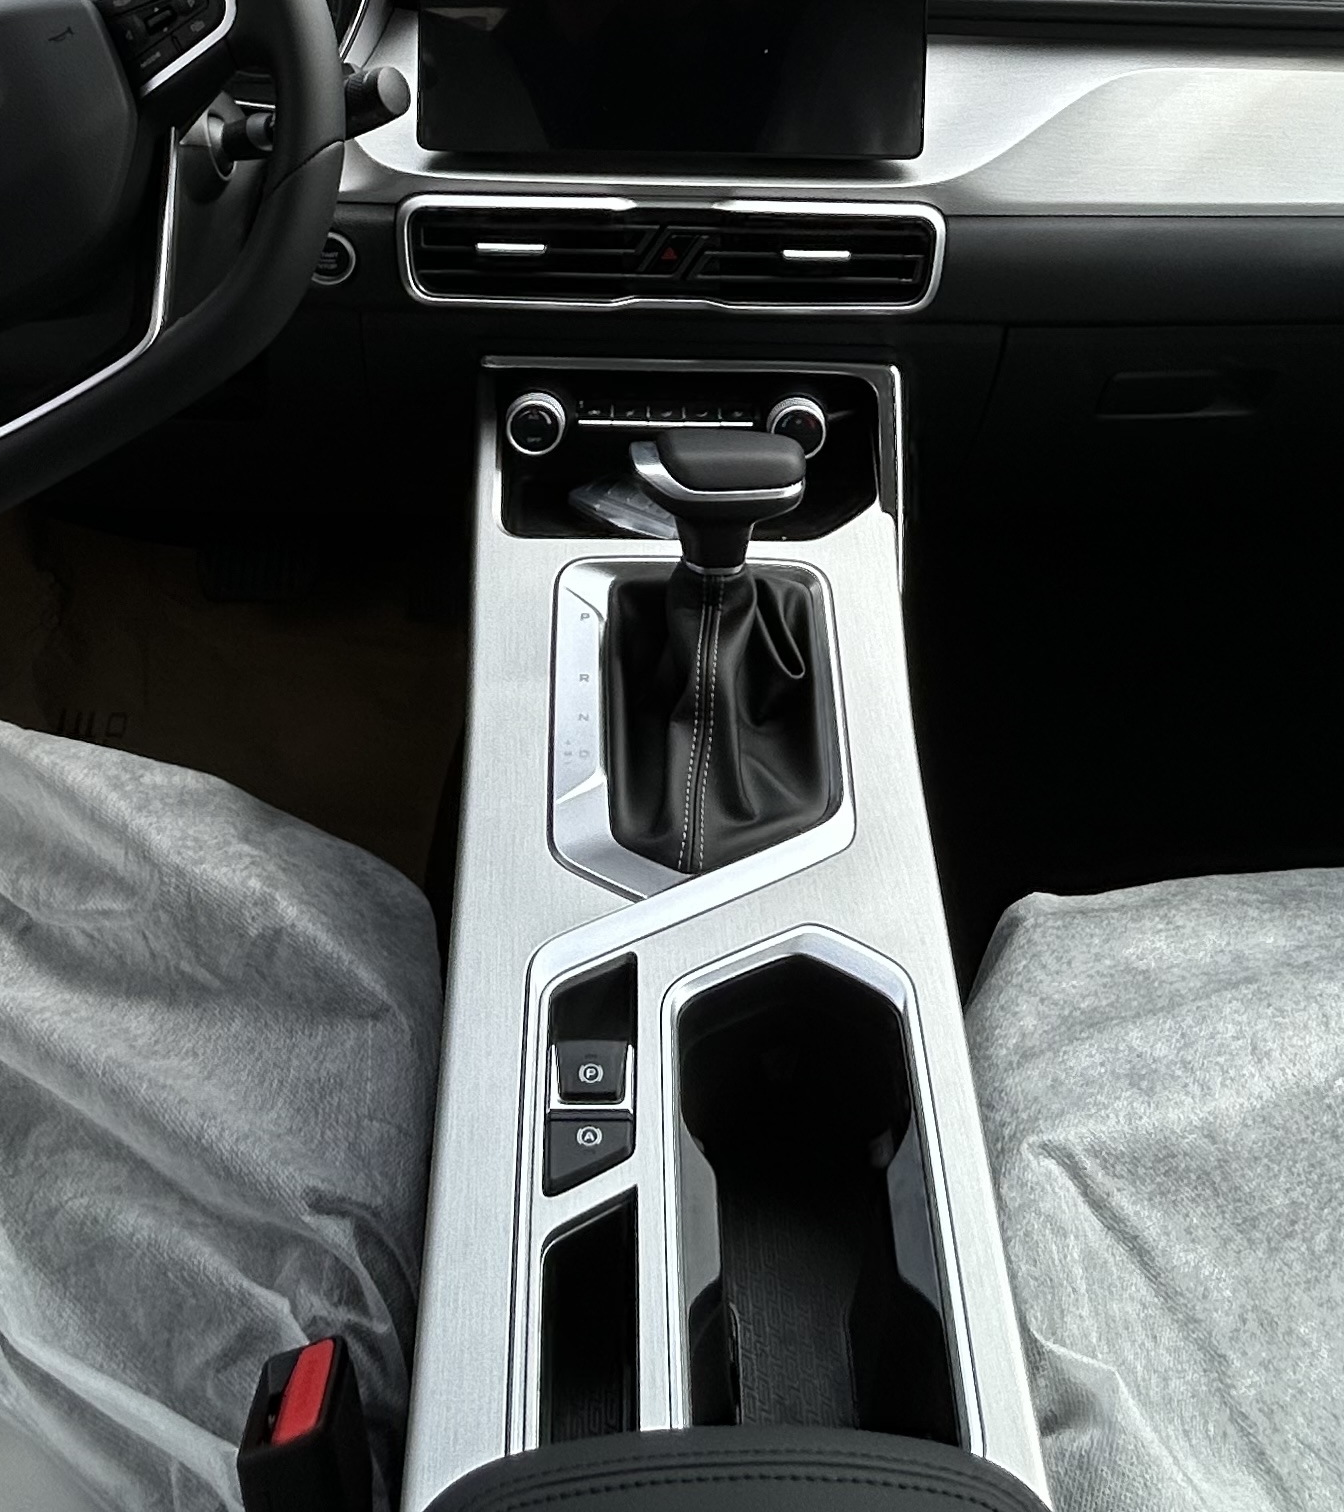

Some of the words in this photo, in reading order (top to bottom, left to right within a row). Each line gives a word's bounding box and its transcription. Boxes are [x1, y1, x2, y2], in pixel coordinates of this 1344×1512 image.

[580, 612, 591, 621] P
[579, 673, 590, 683] R
[578, 713, 590, 722] N
